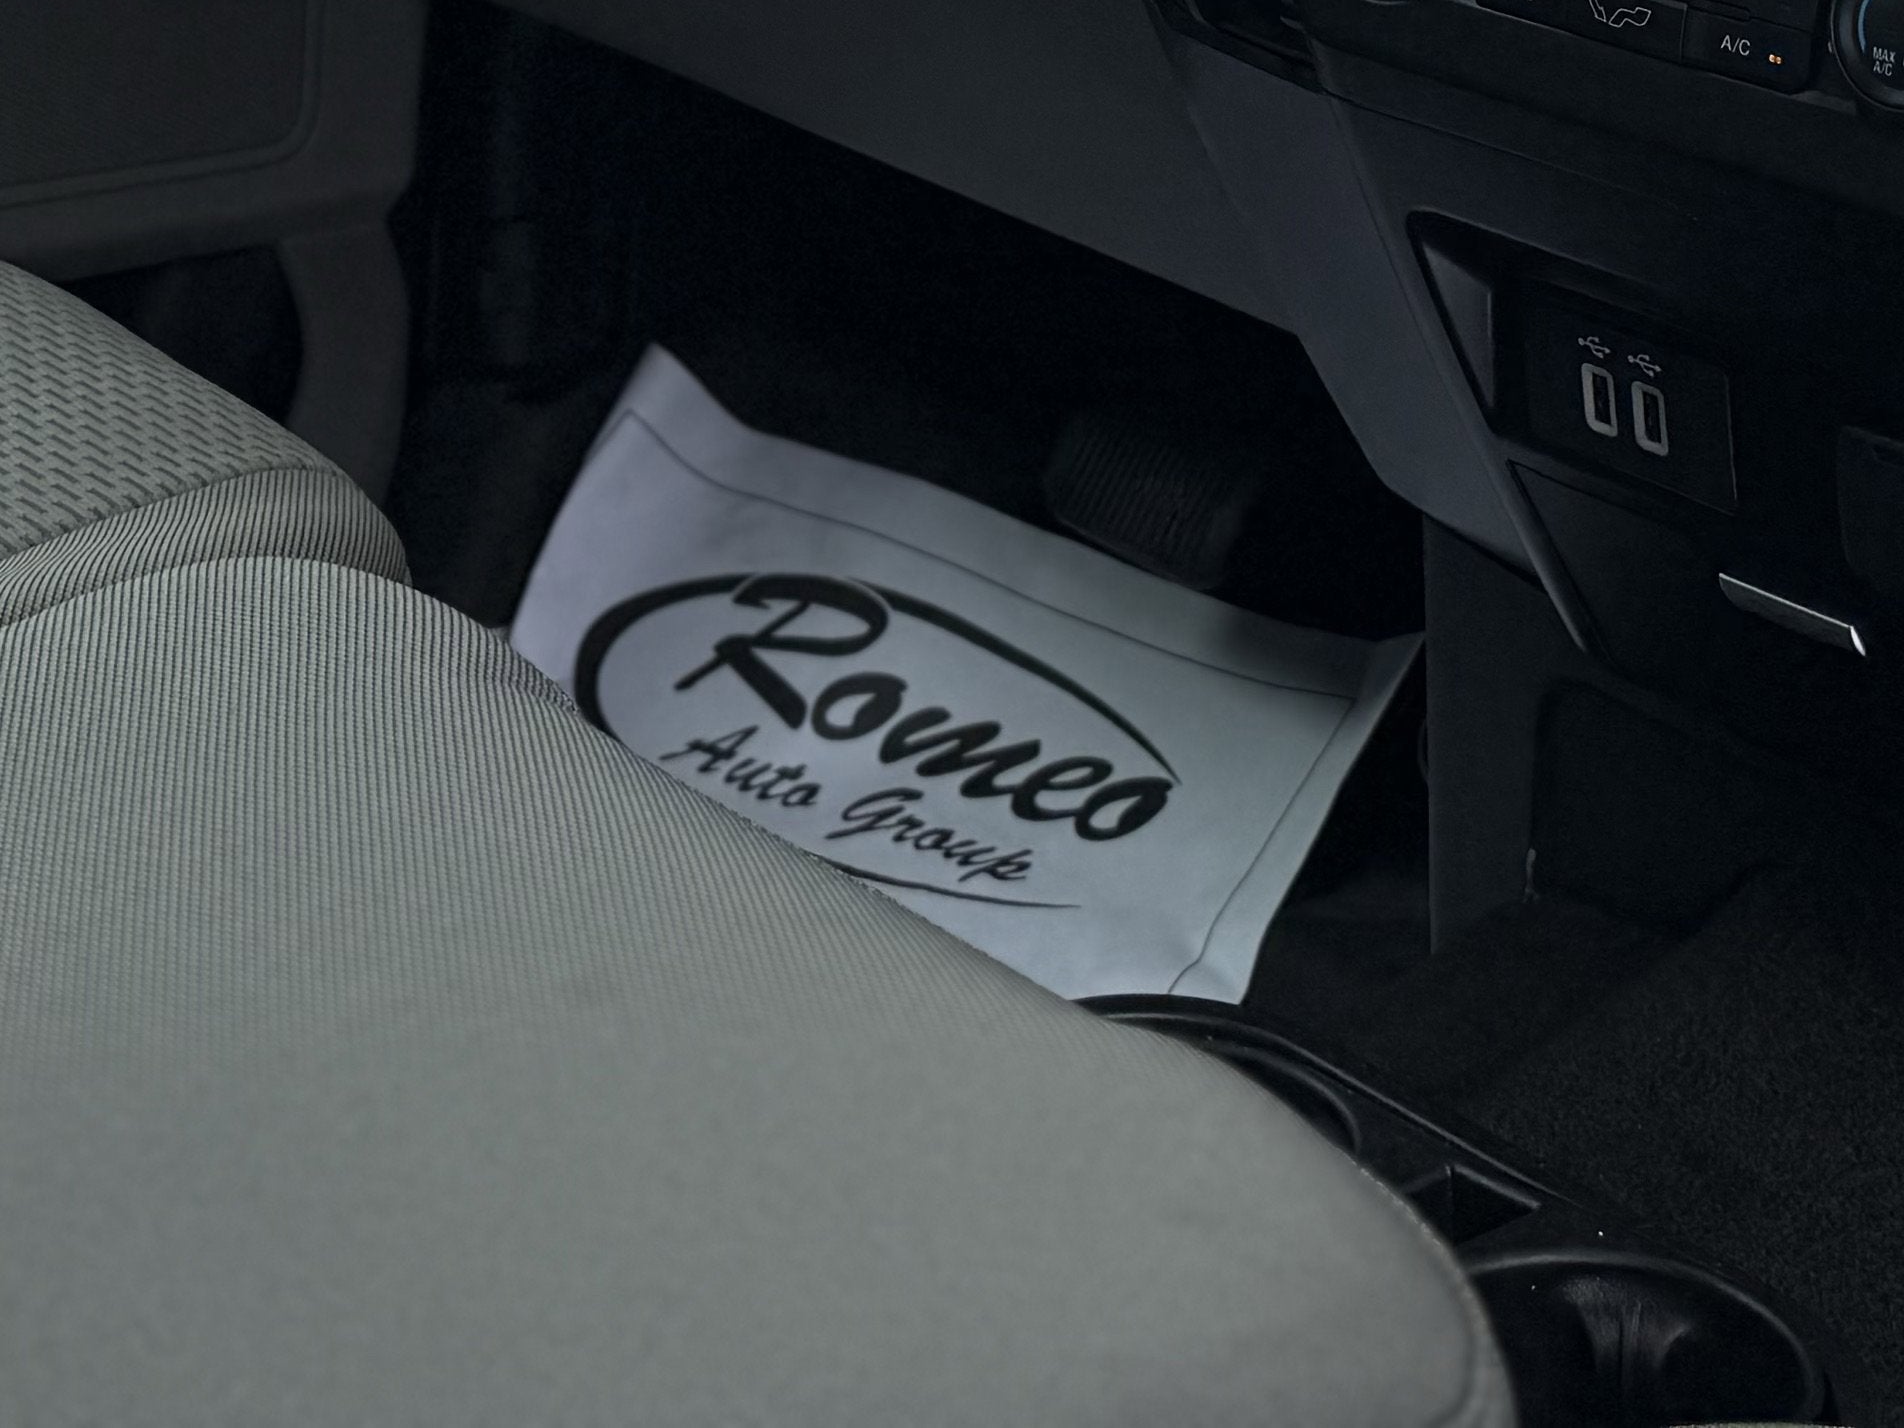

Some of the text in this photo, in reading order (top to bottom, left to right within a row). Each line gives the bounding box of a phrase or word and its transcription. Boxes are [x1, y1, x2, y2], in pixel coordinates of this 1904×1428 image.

[1720, 34, 1751, 57] A/C
[1872, 46, 1896, 64] MAX
[1873, 61, 1893, 77] A/C
[674, 574, 1175, 841] Romeo
[658, 724, 1032, 884] Auto Group
